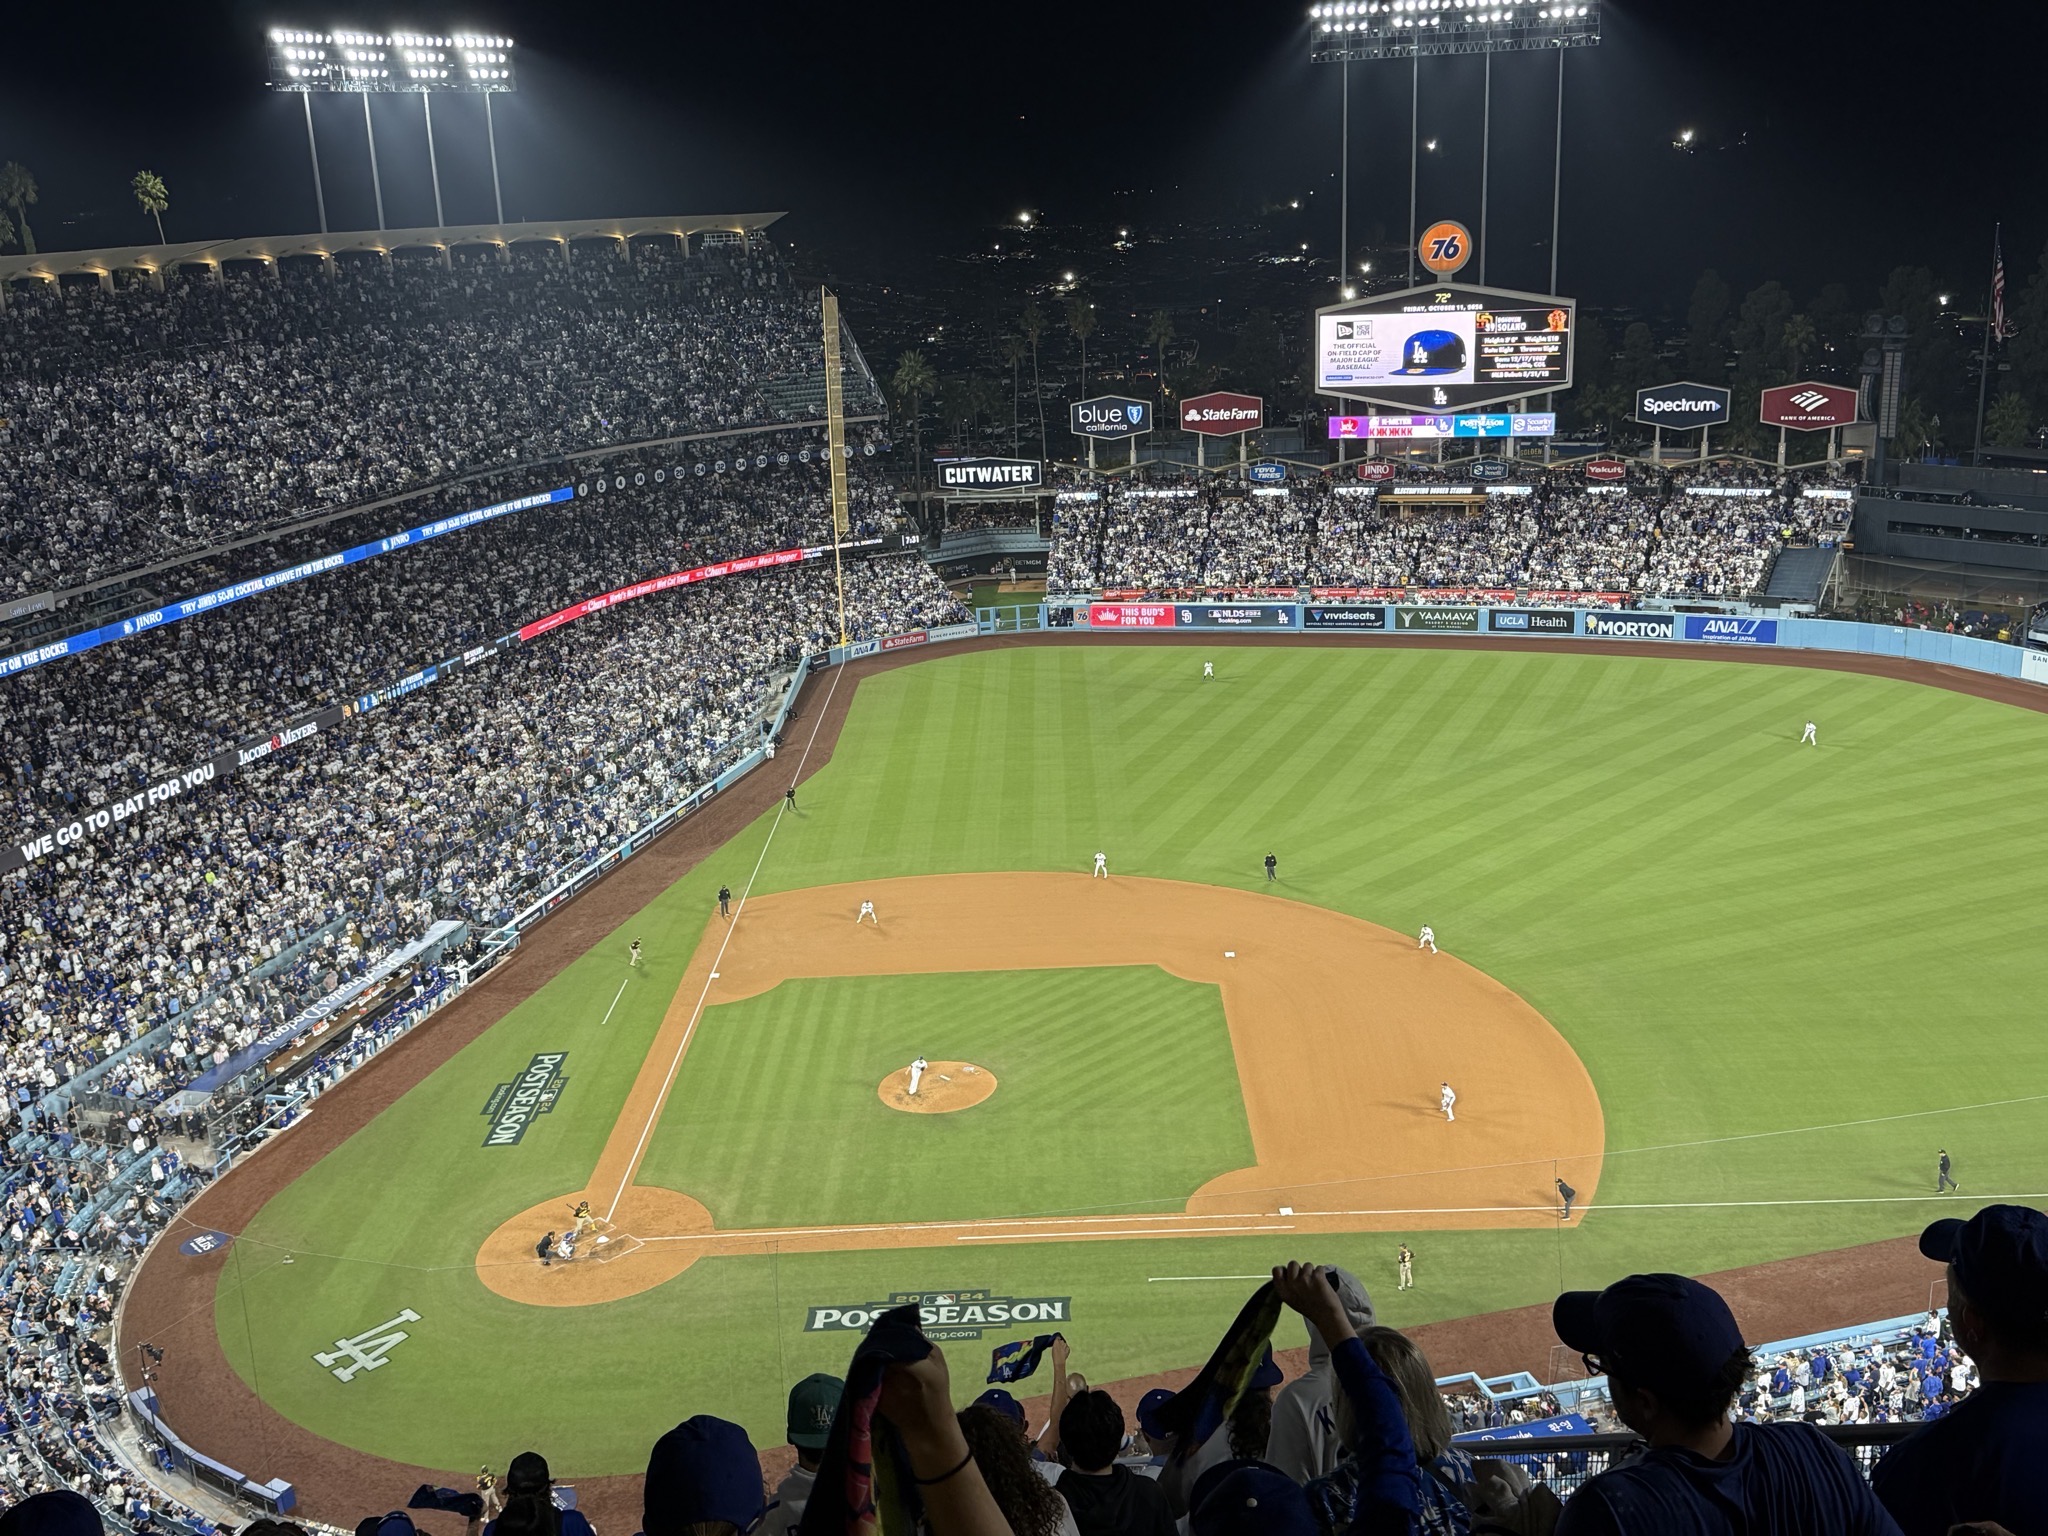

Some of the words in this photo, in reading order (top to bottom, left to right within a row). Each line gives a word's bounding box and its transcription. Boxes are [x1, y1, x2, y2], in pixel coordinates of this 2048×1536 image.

[1429, 235, 1462, 262] 76
[1497, 322, 1527, 331] SOLANO
[1413, 341, 1428, 364] LA
[1433, 387, 1447, 404] LA
[1643, 398, 1716, 414] Spectrum
[1079, 405, 1122, 423] blue
[1086, 423, 1128, 432] california
[1527, 418, 1552, 427] Security
[946, 466, 1033, 484] CUTWATER
[1364, 465, 1389, 476] JINRO
[1485, 464, 1505, 473] Security
[1589, 466, 1624, 474] Yakult
[136, 611, 163, 632] JINRO
[180, 602, 196, 615] TRY
[217, 588, 235, 602] SOJU
[235, 579, 265, 597] COCKTAIL
[276, 571, 295, 585] HAVE
[312, 560, 324, 572] THE
[1076, 612, 1088, 621] 76
[1121, 608, 1140, 616] THIS
[1141, 608, 1165, 616] BUD'S
[1278, 609, 1289, 624] LA
[1323, 611, 1376, 620] vividseats
[1121, 617, 1137, 625] FOR
[1139, 617, 1155, 625] YOU
[1500, 617, 1524, 625] UCLA
[1531, 616, 1567, 627] Health
[1703, 620, 1739, 633] ANA
[1598, 621, 1673, 638] MORTON
[9, 656, 21, 671] ON
[22, 650, 39, 666] THE
[40, 642, 68, 660] ROCKS!
[853, 645, 869, 656] ANA
[353, 701, 359, 713] 0
[363, 698, 369, 710] 2
[21, 833, 54, 862] WE
[57, 821, 83, 846] GO
[85, 810, 110, 833] TO
[112, 793, 145, 822] BAT
[147, 778, 181, 805] FOR
[182, 763, 215, 789] YOU
[321, 969, 375, 1006] Angeles
[257, 1005, 331, 1046] Dodgers
[488, 1054, 563, 1145] POSTSEASON
[896, 1295, 920, 1303] 20
[812, 1302, 1063, 1330] POSSEASON
[312, 1307, 423, 1384] LA
